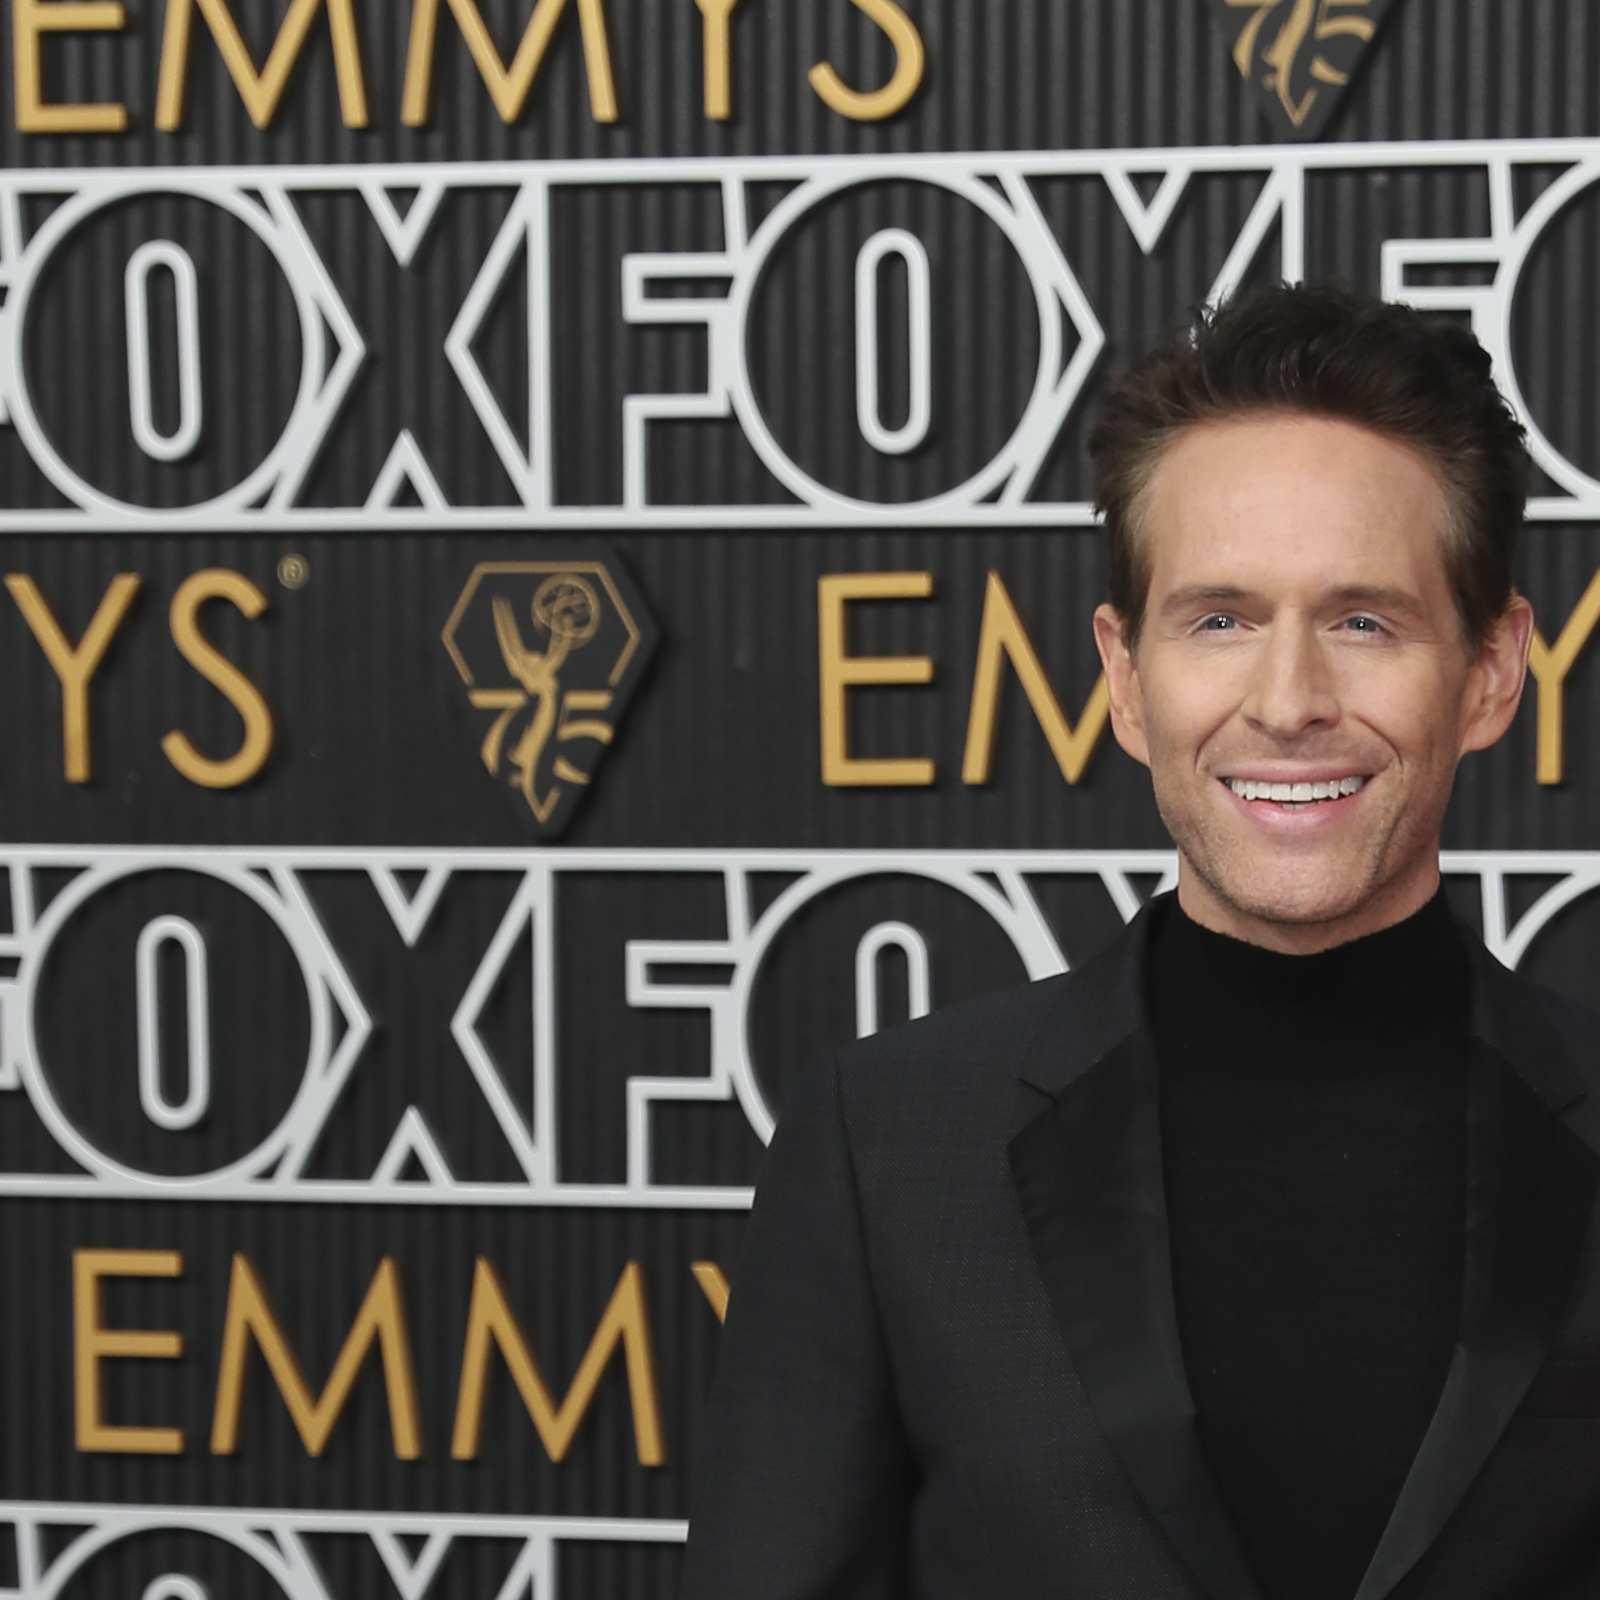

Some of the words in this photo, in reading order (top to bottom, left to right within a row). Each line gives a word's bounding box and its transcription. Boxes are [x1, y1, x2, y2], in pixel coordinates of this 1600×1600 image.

[0, 163, 549, 532] OX
[0, 845, 554, 1205] OX
[72, 1249, 732, 1467] EMM
